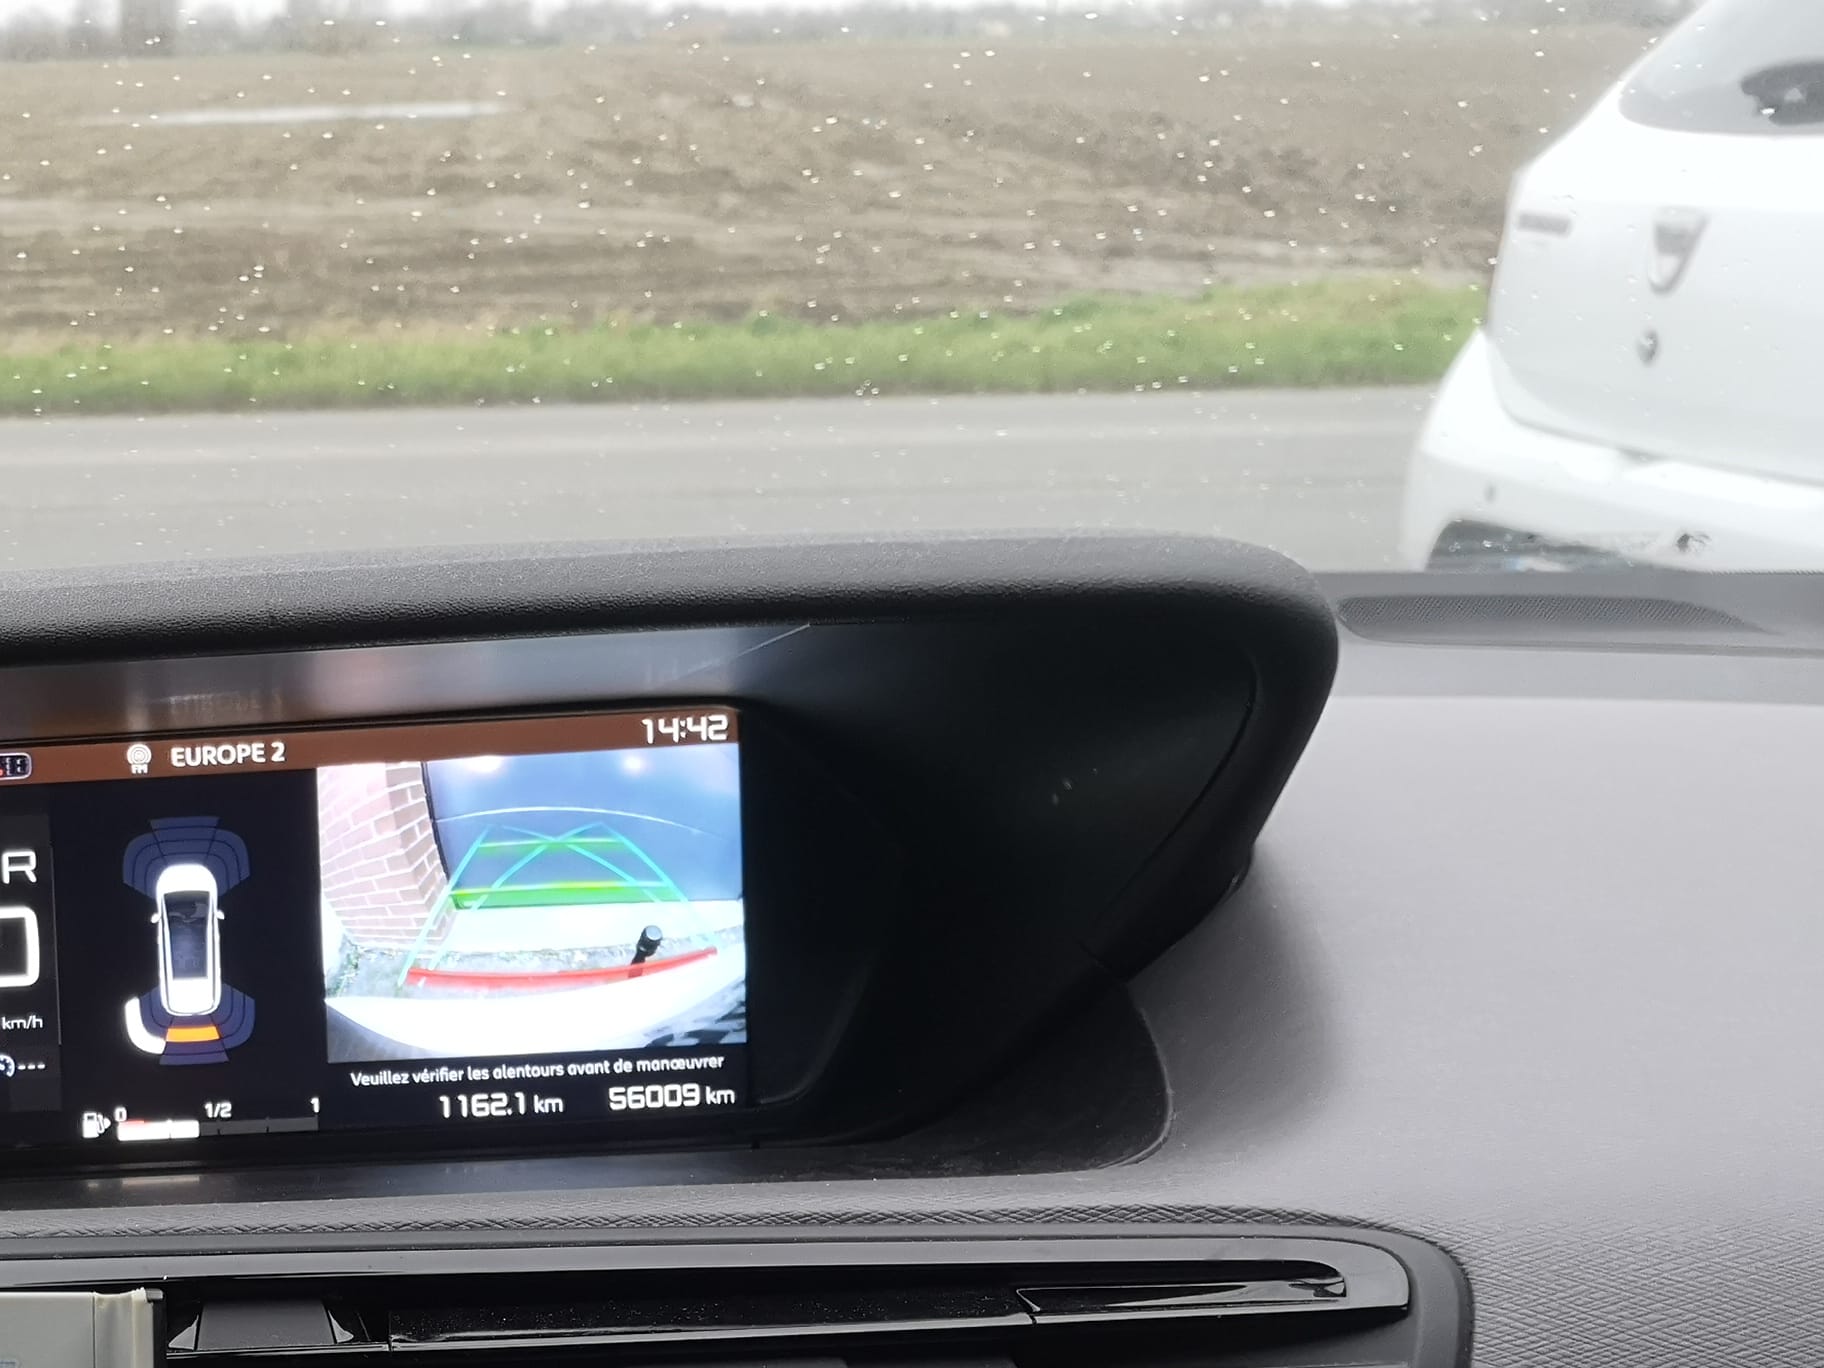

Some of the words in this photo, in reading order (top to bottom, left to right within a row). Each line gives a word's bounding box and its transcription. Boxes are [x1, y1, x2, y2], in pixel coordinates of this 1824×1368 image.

[642, 714, 728, 744] 14:42
[170, 743, 266, 767] EUROPE
[271, 741, 285, 762] 2
[1, 849, 37, 883] R
[1, 1014, 44, 1031] km/h
[350, 1069, 409, 1087] Veuillez
[412, 1065, 464, 1083] vérifier
[467, 1065, 489, 1080] les
[492, 1063, 564, 1080] alentours
[568, 1060, 610, 1076] avant
[613, 1058, 633, 1073] de
[311, 1097, 320, 1113] 1
[534, 1094, 563, 1113] km
[608, 1083, 700, 1110] 56009
[705, 1086, 735, 1105] km
[114, 1107, 127, 1122] 0
[204, 1102, 232, 1118] 1/2
